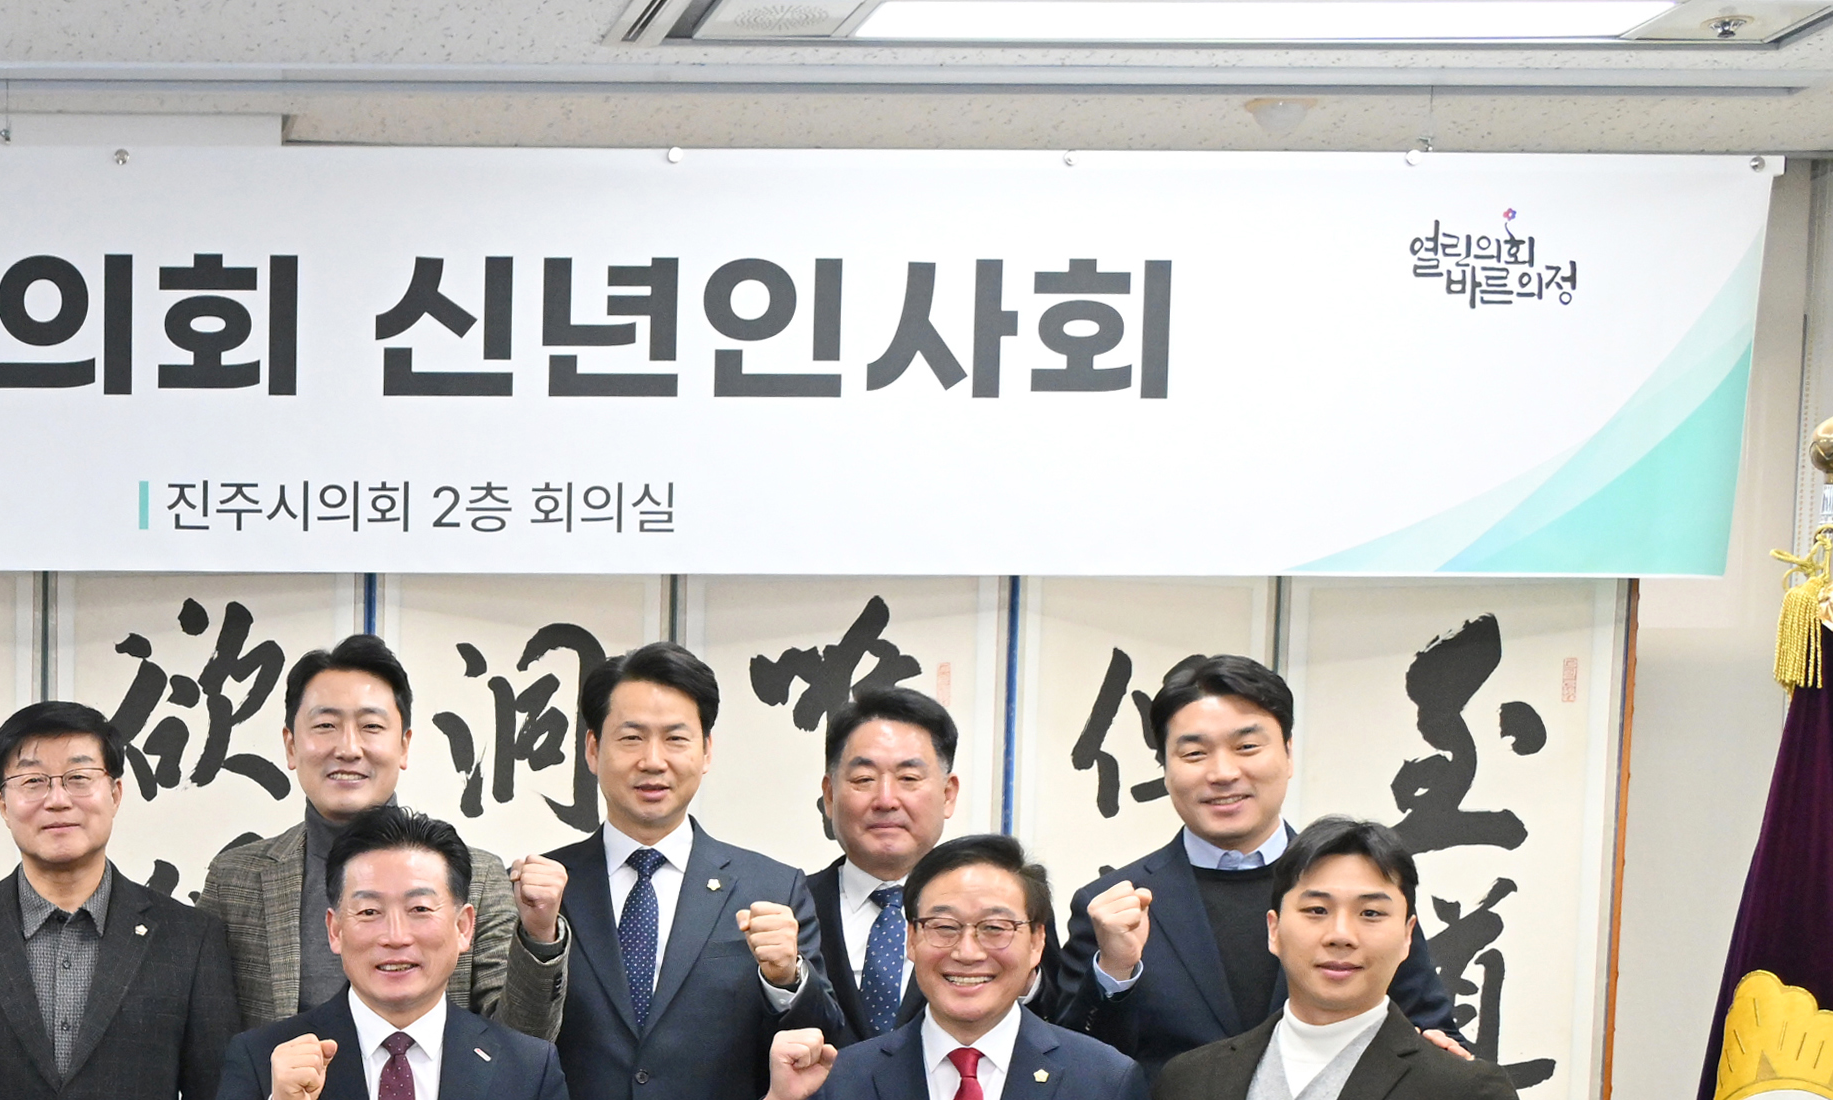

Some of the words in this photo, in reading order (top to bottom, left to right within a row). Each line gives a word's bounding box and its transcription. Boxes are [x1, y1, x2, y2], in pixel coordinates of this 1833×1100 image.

[1409, 219, 1535, 277] 열린의회
[1445, 260, 1577, 309] 바른의정
[375, 256, 1172, 399] 신년인사회
[167, 480, 409, 532] 진주시의회
[433, 482, 512, 532] 2층
[531, 482, 674, 533] 회의실
